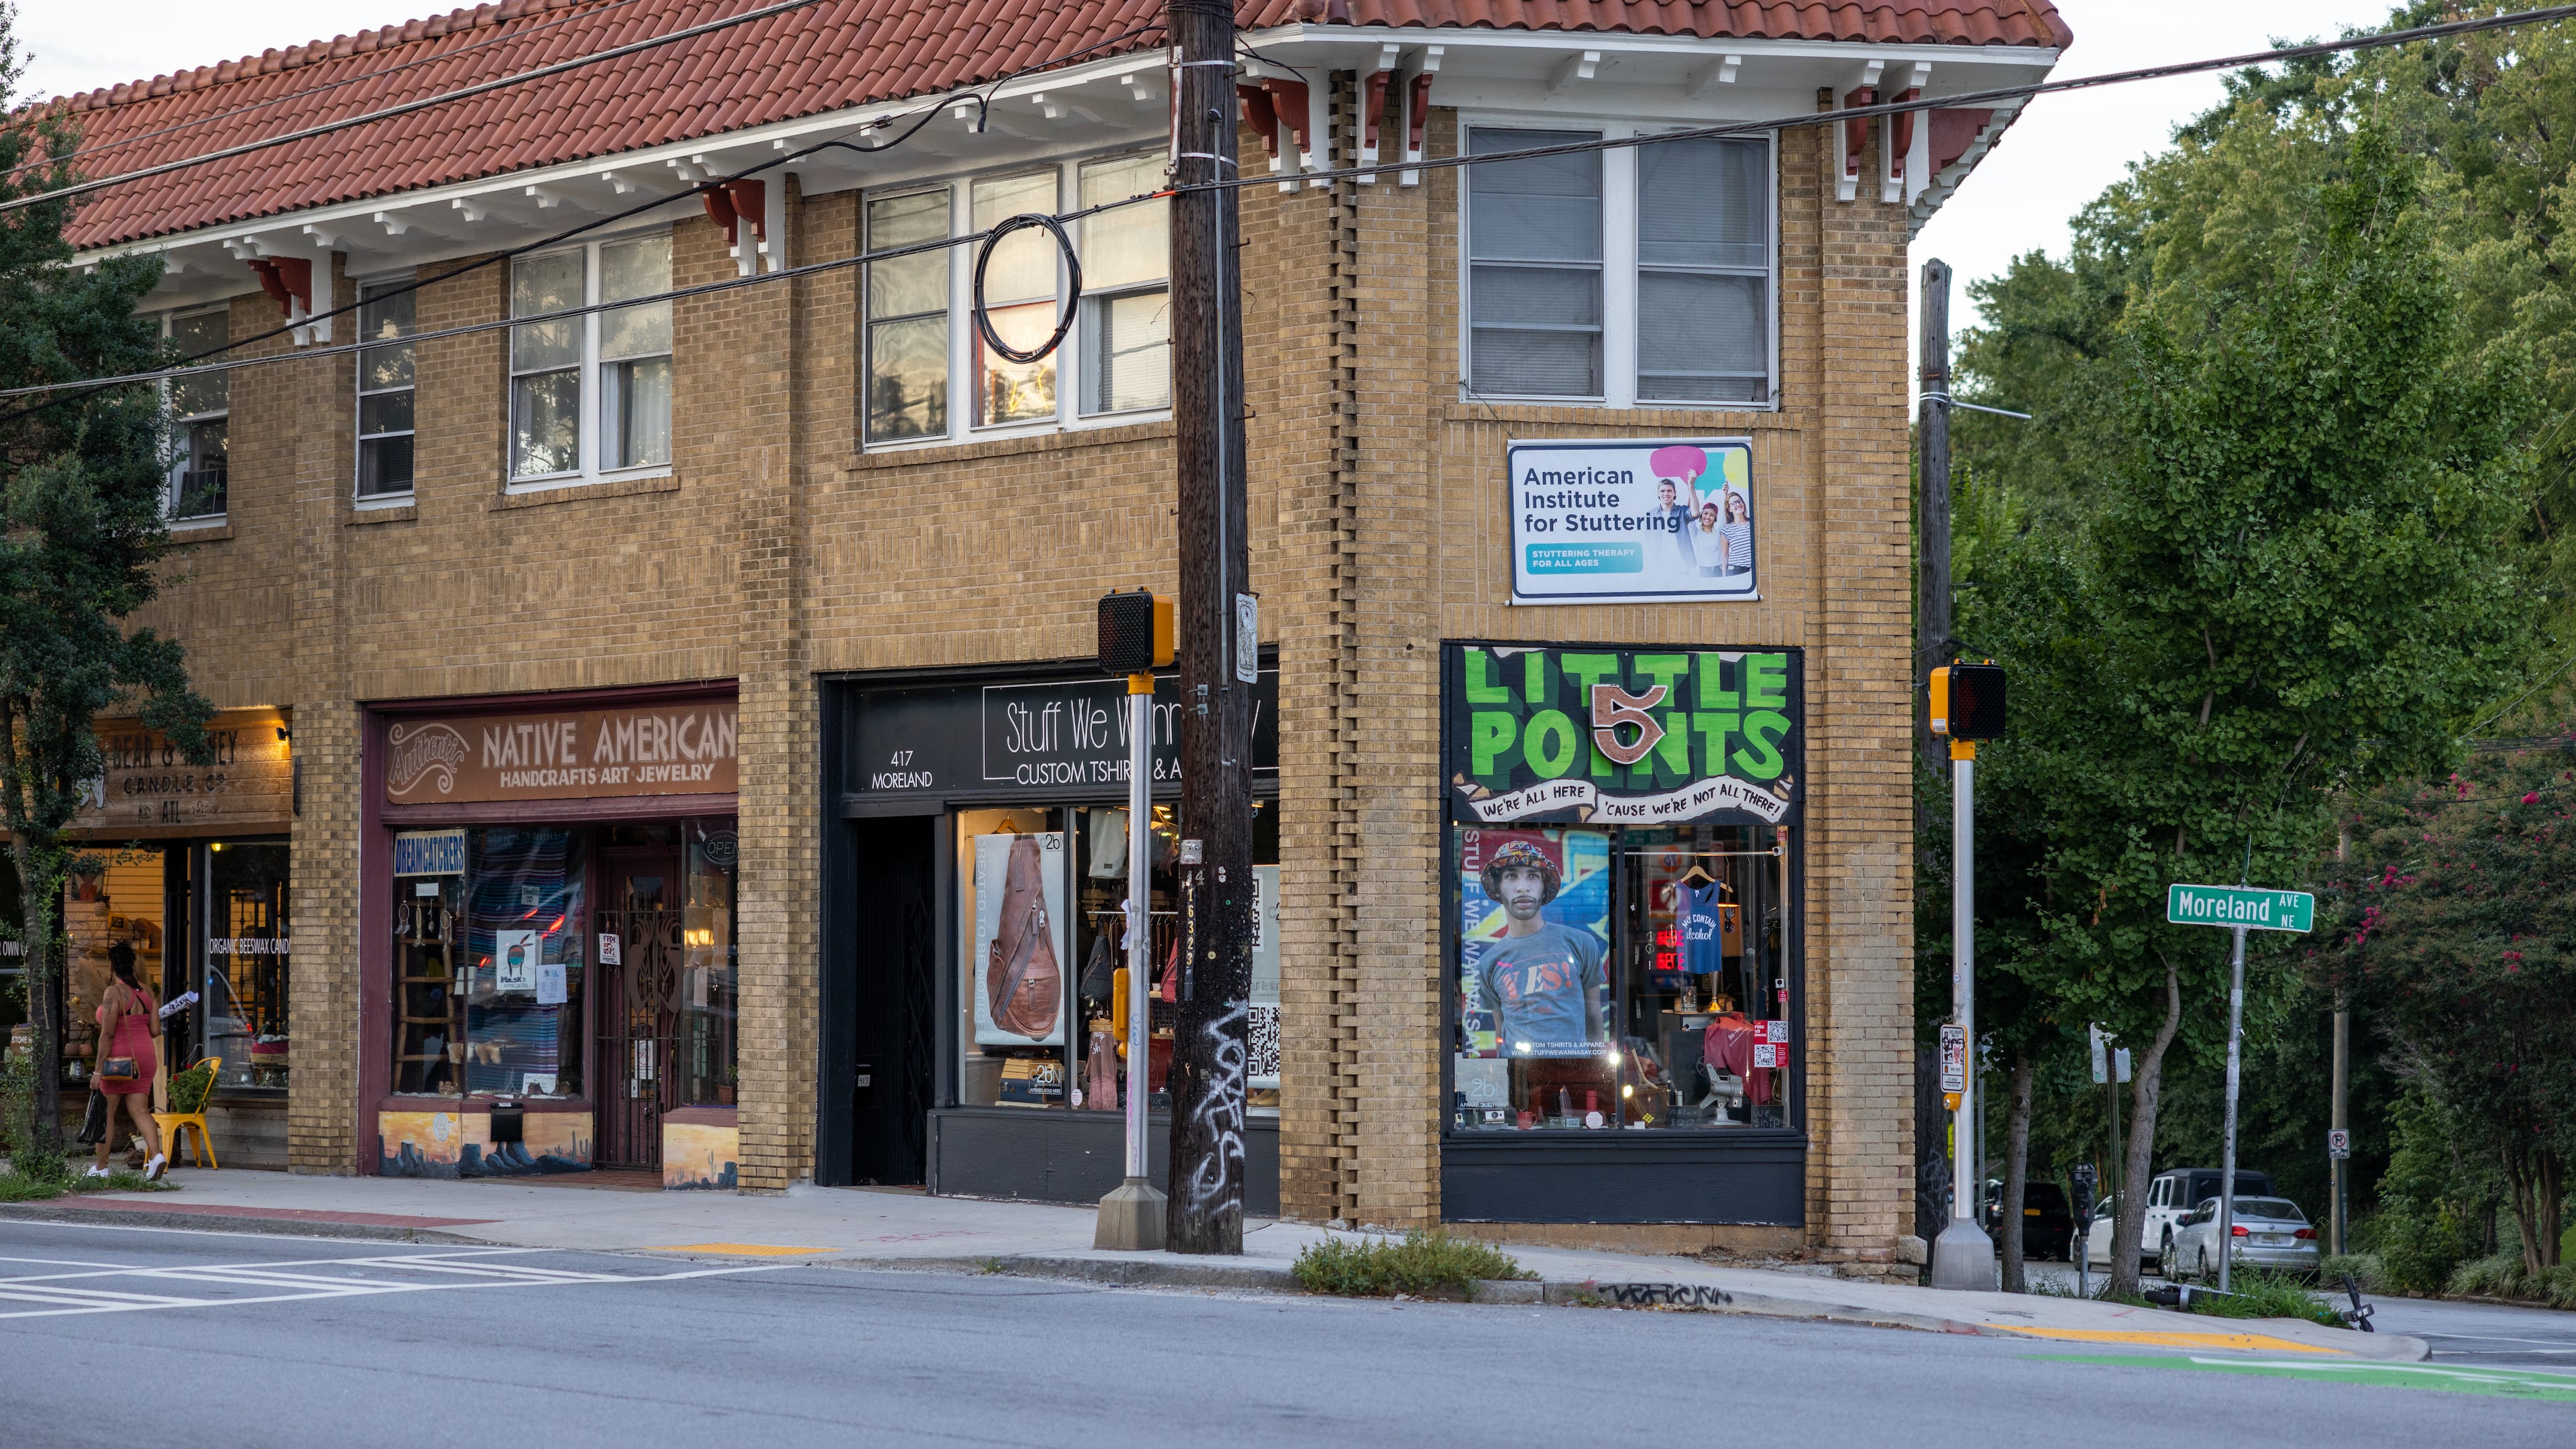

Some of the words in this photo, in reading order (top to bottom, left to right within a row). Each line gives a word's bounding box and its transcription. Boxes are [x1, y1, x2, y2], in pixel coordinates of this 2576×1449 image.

[1523, 467, 1633, 486] American
[1525, 490, 1619, 509] Institute
[1525, 515, 1558, 532] for
[1566, 513, 1680, 533] Stuttering
[1464, 650, 1787, 710] LITTLE
[1008, 702, 1062, 753] Stuff
[1071, 697, 1108, 750] We
[1589, 684, 1668, 765] 5
[482, 720, 576, 769] NATIVE
[593, 711, 737, 765] AMERICAN
[388, 733, 465, 786] Authentic
[891, 750, 914, 767] 417
[1016, 760, 1086, 785] CUSTOM
[1089, 759, 1131, 782] TSHIR
[1154, 757, 1167, 780] &
[123, 774, 195, 795] CANDLE
[500, 767, 596, 788] HANDCRAFTS
[600, 767, 630, 784] ART
[636, 763, 716, 783] JEWELRY
[872, 771, 933, 790] MORELAND
[161, 800, 182, 824] ATL
[1483, 798, 1519, 817] WE'RE
[1526, 790, 1547, 806] ALL
[1554, 786, 1585, 798] HERE
[1605, 801, 1646, 816] 'CAUSE
[1652, 797, 1687, 815] WE'RE
[1693, 787, 1715, 806] NOT
[1720, 784, 1739, 798] ALL
[1743, 788, 1780, 816] THERE!
[396, 835, 464, 874] DREAMCATCHERS
[1464, 829, 1480, 894] STUFF
[977, 839, 986, 911] CREATED
[1464, 900, 1480, 931] WE
[2179, 891, 2270, 922] Moreland
[2279, 894, 2300, 908] AVE
[977, 916, 986, 937] TO
[1692, 914, 1717, 930] CONTAIN
[2281, 914, 2295, 928] NE
[3, 941, 19, 956] OWN
[209, 938, 238, 955] ORGANIC
[239, 938, 270, 955] BEESWAX
[977, 943, 986, 964] BE
[1464, 938, 1481, 1014] WANNA
[976, 970, 986, 1040] NOTICED
[11, 1036, 28, 1044] STORE
[1464, 1018, 1481, 1058] SAY
